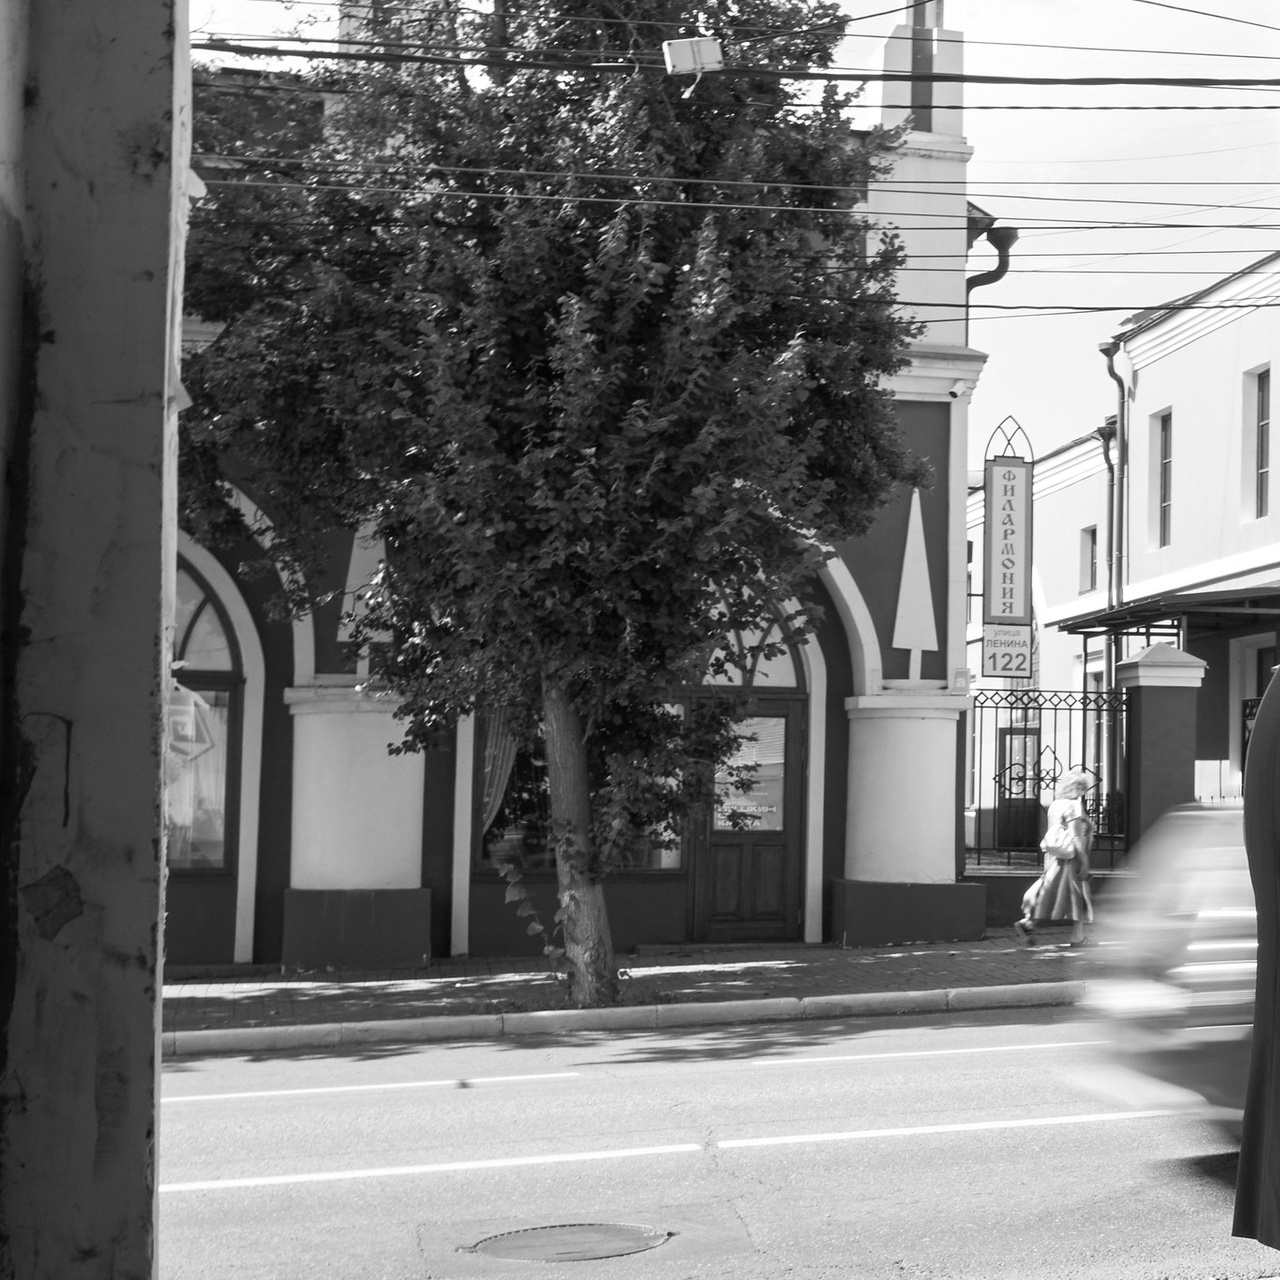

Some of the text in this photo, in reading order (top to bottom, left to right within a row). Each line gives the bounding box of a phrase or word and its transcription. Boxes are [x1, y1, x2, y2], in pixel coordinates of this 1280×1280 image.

[1001, 470, 1017, 615] ФИЛАРМОНИЯ
[993, 630, 1021, 638] улица
[986, 639, 1028, 648] ЛЕНИНА
[988, 652, 1027, 671] 122
